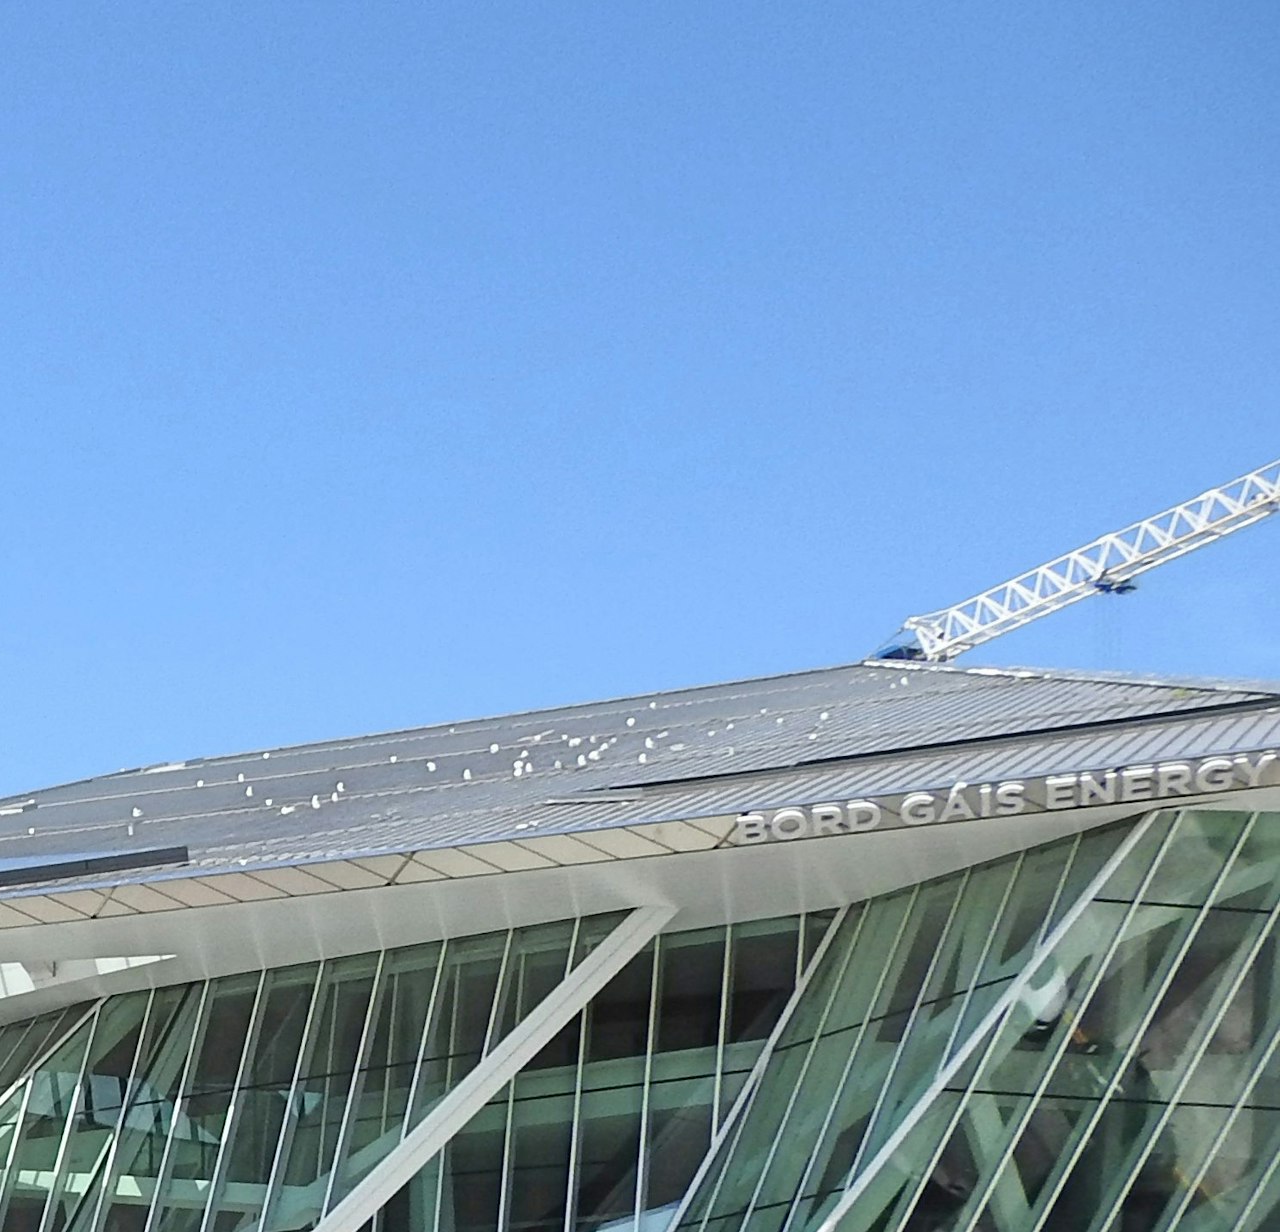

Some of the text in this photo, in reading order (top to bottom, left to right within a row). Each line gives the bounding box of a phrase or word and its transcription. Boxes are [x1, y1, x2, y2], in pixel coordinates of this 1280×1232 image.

[735, 752, 1278, 845] BORD GÁIS ENERGY
